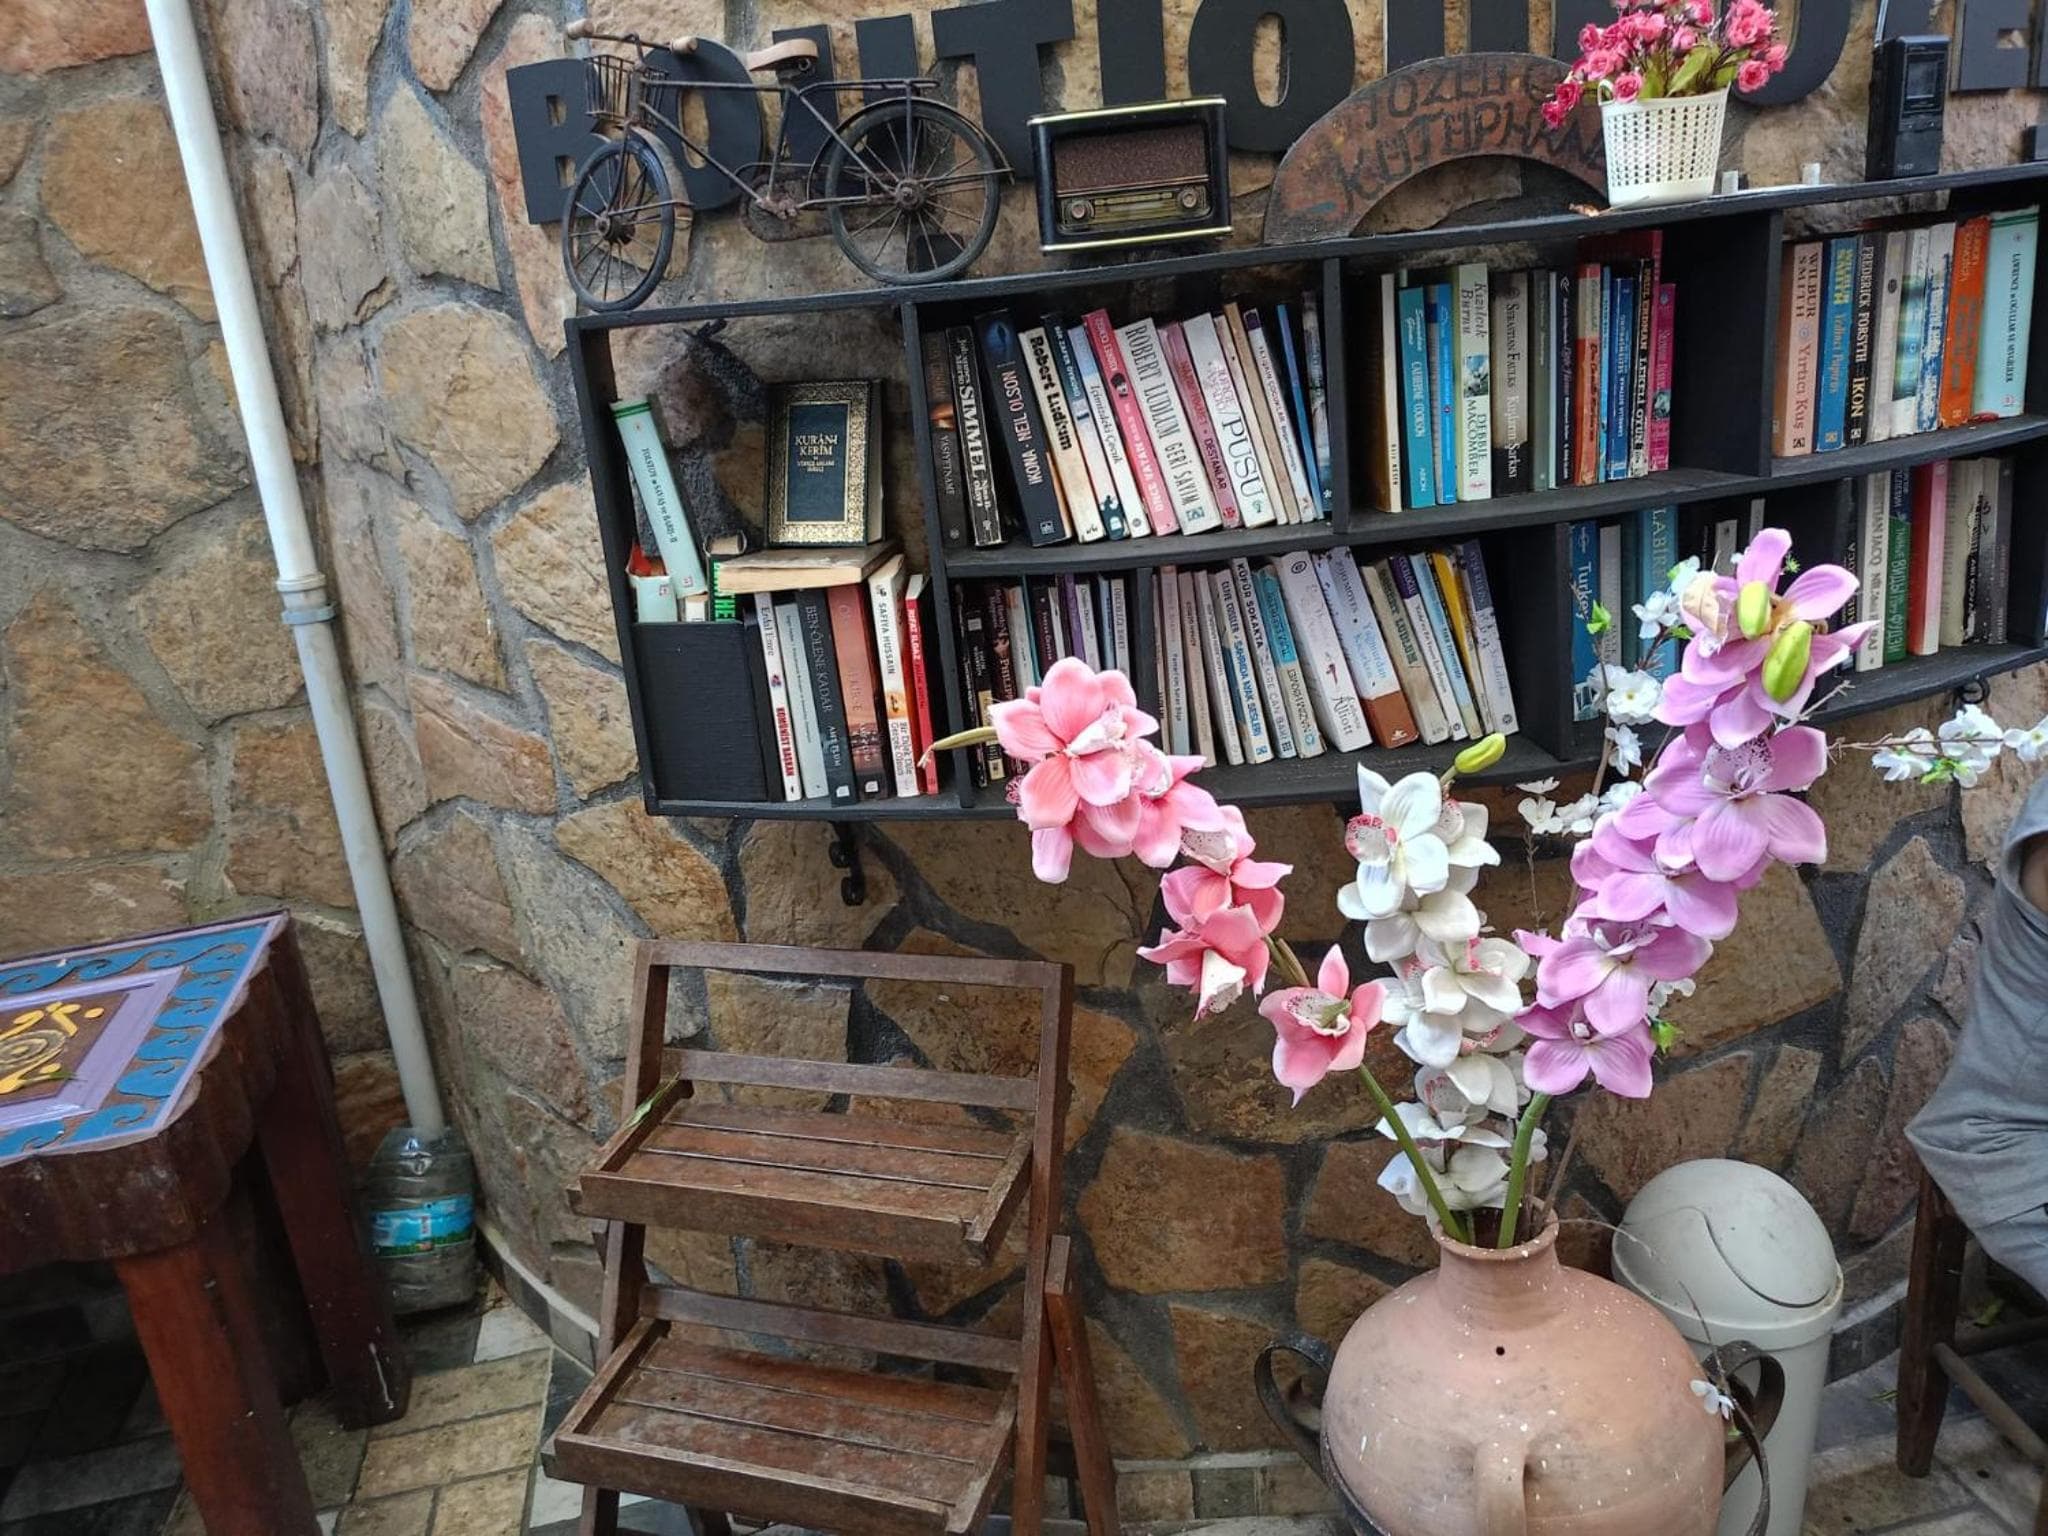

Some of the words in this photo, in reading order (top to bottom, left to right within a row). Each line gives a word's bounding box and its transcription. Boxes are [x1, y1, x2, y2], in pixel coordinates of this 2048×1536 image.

[1794, 255, 1808, 316] SMITH
[1803, 252, 1819, 316] WILBUR
[1858, 244, 1874, 306] FREDERICK
[1460, 288, 1474, 335] Burnu
[1473, 281, 1487, 337] Kızılcık
[1124, 323, 1163, 382] ROBERT
[1854, 311, 1870, 361] FORSYTH
[1794, 342, 1810, 394] Yırtıcı
[1001, 369, 1025, 412] OLSON
[1027, 334, 1058, 390] Robert
[1044, 390, 1076, 451] Ludlum
[1142, 382, 1181, 439] LUDLUM
[958, 384, 987, 479] SIMMEL
[1011, 412, 1032, 442] NEIL
[1791, 399, 1807, 429] Kuş
[1163, 439, 1191, 469] GERİ
[1220, 414, 1264, 499] PUSU
[1465, 399, 1479, 476] MACOMBER
[1476, 414, 1488, 459] DEBBIE
[1132, 439, 1154, 482] VATAN
[1203, 436, 1227, 490] DESTANLAR
[1504, 443, 1520, 478] Şarkısı
[651, 484, 666, 506] SAVAŞ
[1172, 469, 1200, 506] SAYIM
[1219, 580, 1232, 600] CLIVE
[1575, 561, 1591, 619] Turkey
[1888, 559, 1906, 593] ВИДЫ
[760, 606, 773, 630] Erdal
[877, 602, 889, 633] SAFIYA
[1235, 561, 1253, 597] KÜFÜR
[1244, 599, 1264, 648] SOKAKTA
[764, 631, 776, 656] Emre
[882, 635, 895, 674] HUSSAIN
[815, 671, 833, 712] KADAR
[998, 657, 1015, 701] PHILIPP
[889, 721, 901, 748] Gerçek
[898, 721, 908, 733] Bir
[1330, 695, 1356, 736] Alliott
[781, 746, 795, 777] BAŞKAN
[900, 734, 910, 756] Dilek
